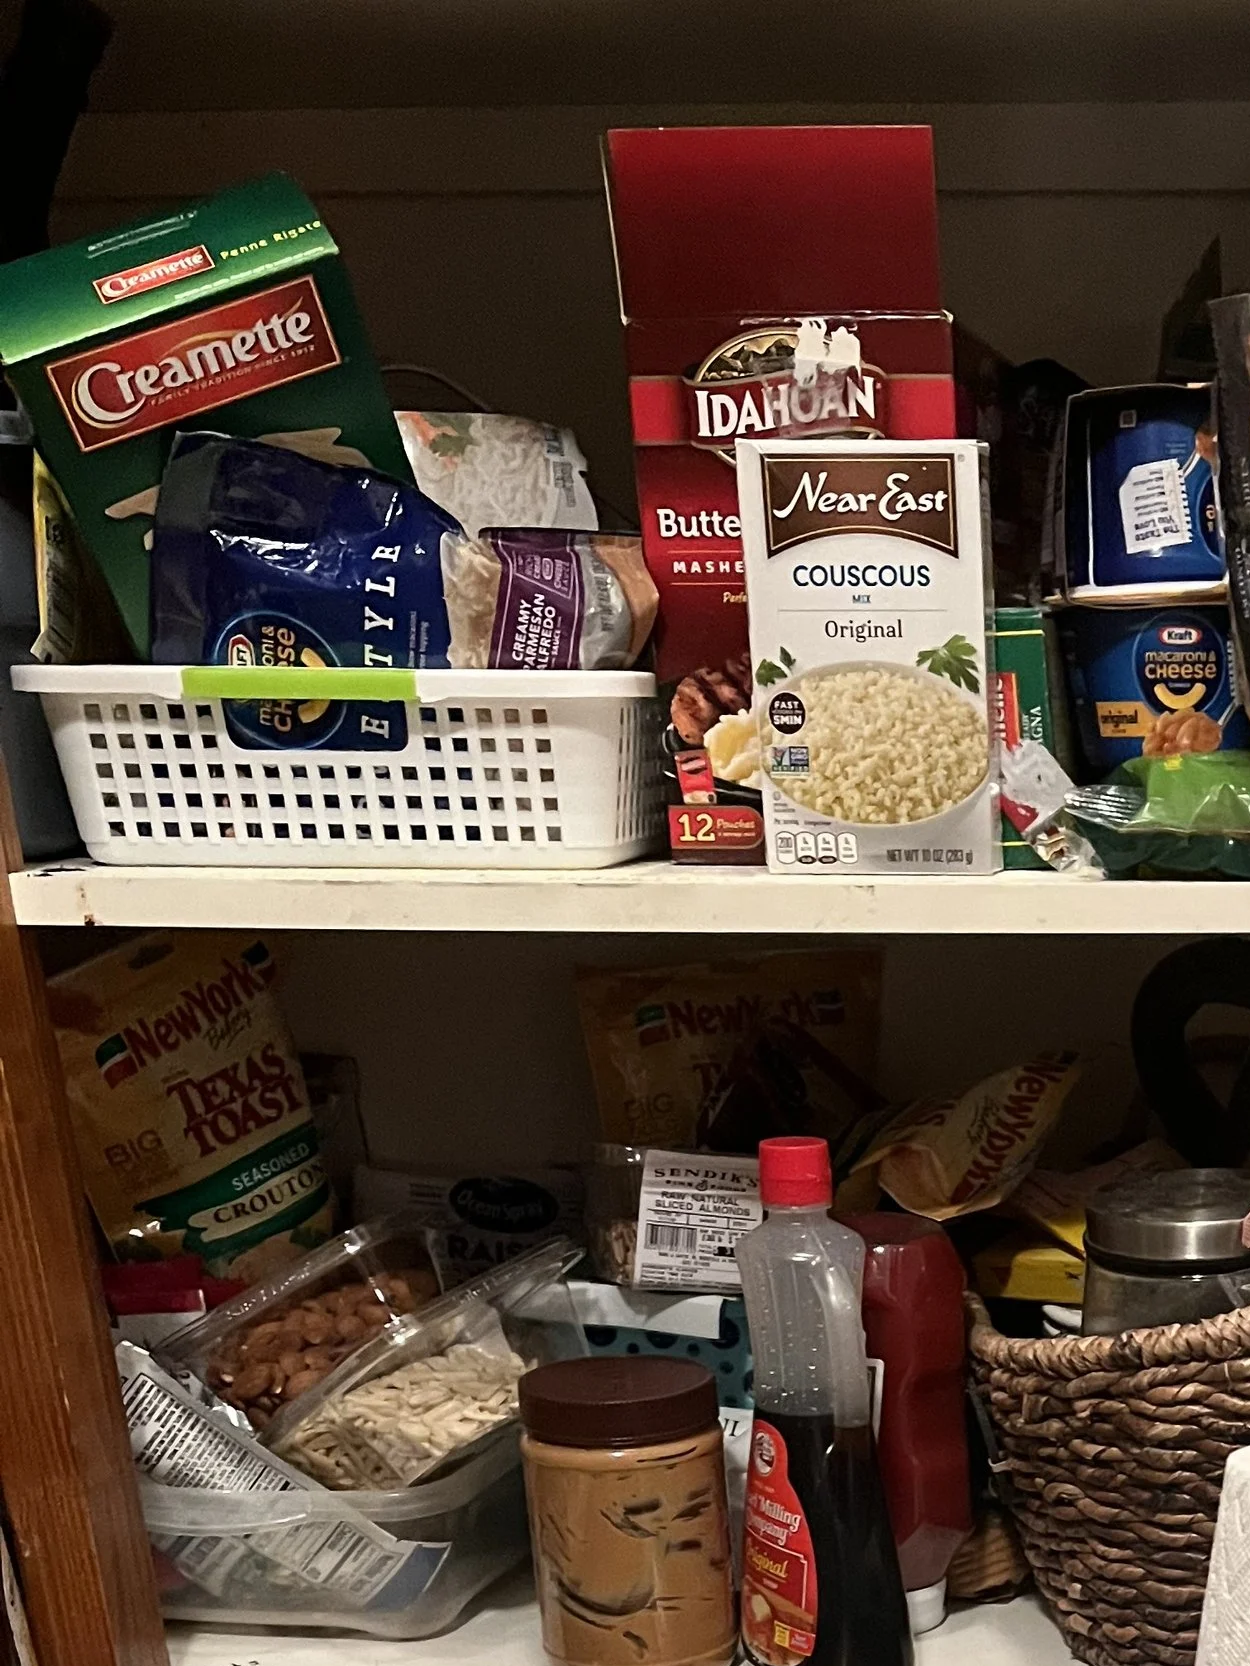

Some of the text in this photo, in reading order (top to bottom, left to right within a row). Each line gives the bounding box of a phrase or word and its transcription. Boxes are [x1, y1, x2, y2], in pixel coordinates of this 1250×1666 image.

[221, 220, 321, 260] Penne Rigate
[101, 253, 204, 299] Creamette
[73, 304, 315, 426] Creamette
[253, 355, 288, 374] SINCE
[772, 471, 949, 520] Near East
[656, 508, 742, 539] Butte
[672, 560, 744, 575] MASHE
[792, 564, 932, 588] COUSCOUS
[360, 544, 401, 739] ETYLE
[511, 599, 532, 662] CREAMY
[524, 593, 546, 671] PARMESAN
[537, 605, 557, 671] ALFREDO
[824, 619, 904, 643] Original
[1166, 630, 1193, 641] Kraft
[1145, 651, 1207, 662] macaroni
[774, 700, 800, 710] FAST
[1101, 709, 1139, 728] original
[678, 812, 717, 843] 12
[166, 1042, 287, 1119] TEXAS
[183, 1075, 307, 1158] TOAST
[104, 1129, 164, 1168] BIG
[231, 1142, 310, 1193] SEASONED
[653, 1167, 759, 1189] SENDIK'S
[212, 1159, 325, 1226] CROUTON
[655, 1199, 751, 1217] SLICED ALMONDS
[661, 1191, 740, 1206] RAW NATURAL
